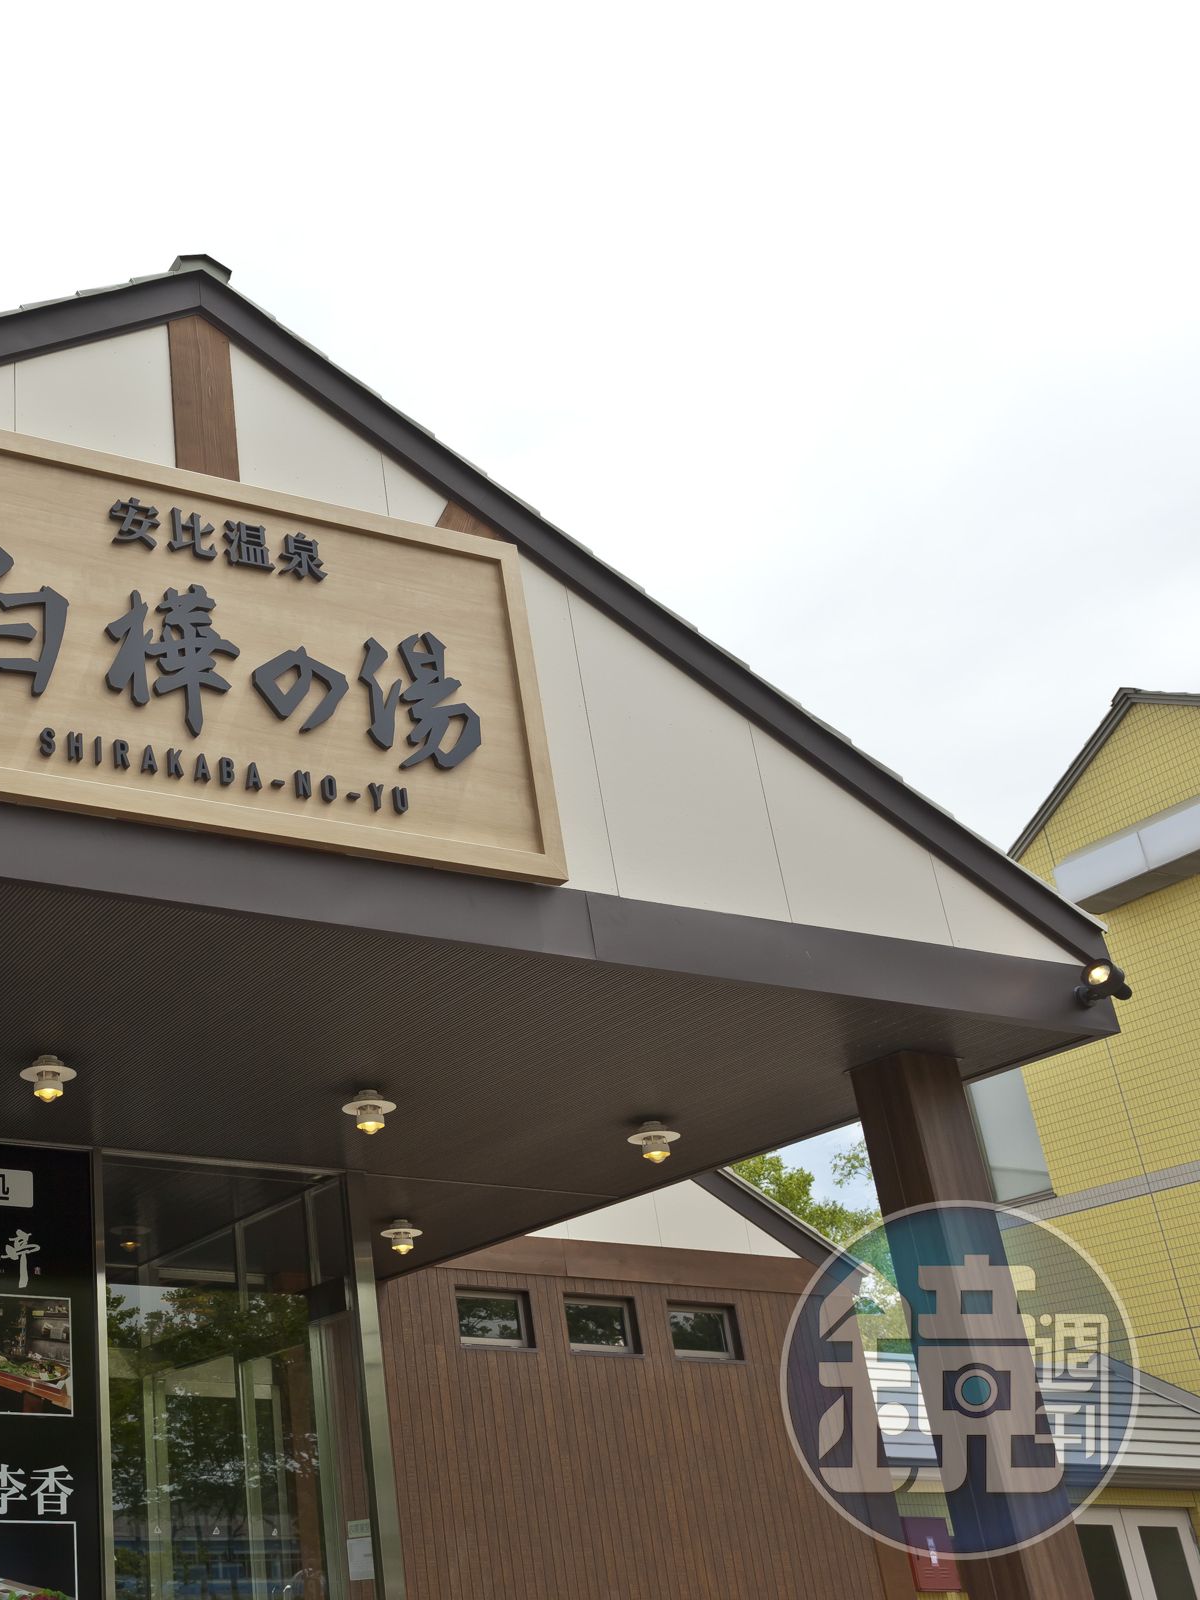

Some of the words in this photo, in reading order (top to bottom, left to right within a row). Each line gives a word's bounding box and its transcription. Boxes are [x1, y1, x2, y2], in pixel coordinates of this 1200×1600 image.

[110, 497, 328, 582] 安比温泉
[39, 727, 409, 815] SHIRAKABA-NO-YU
